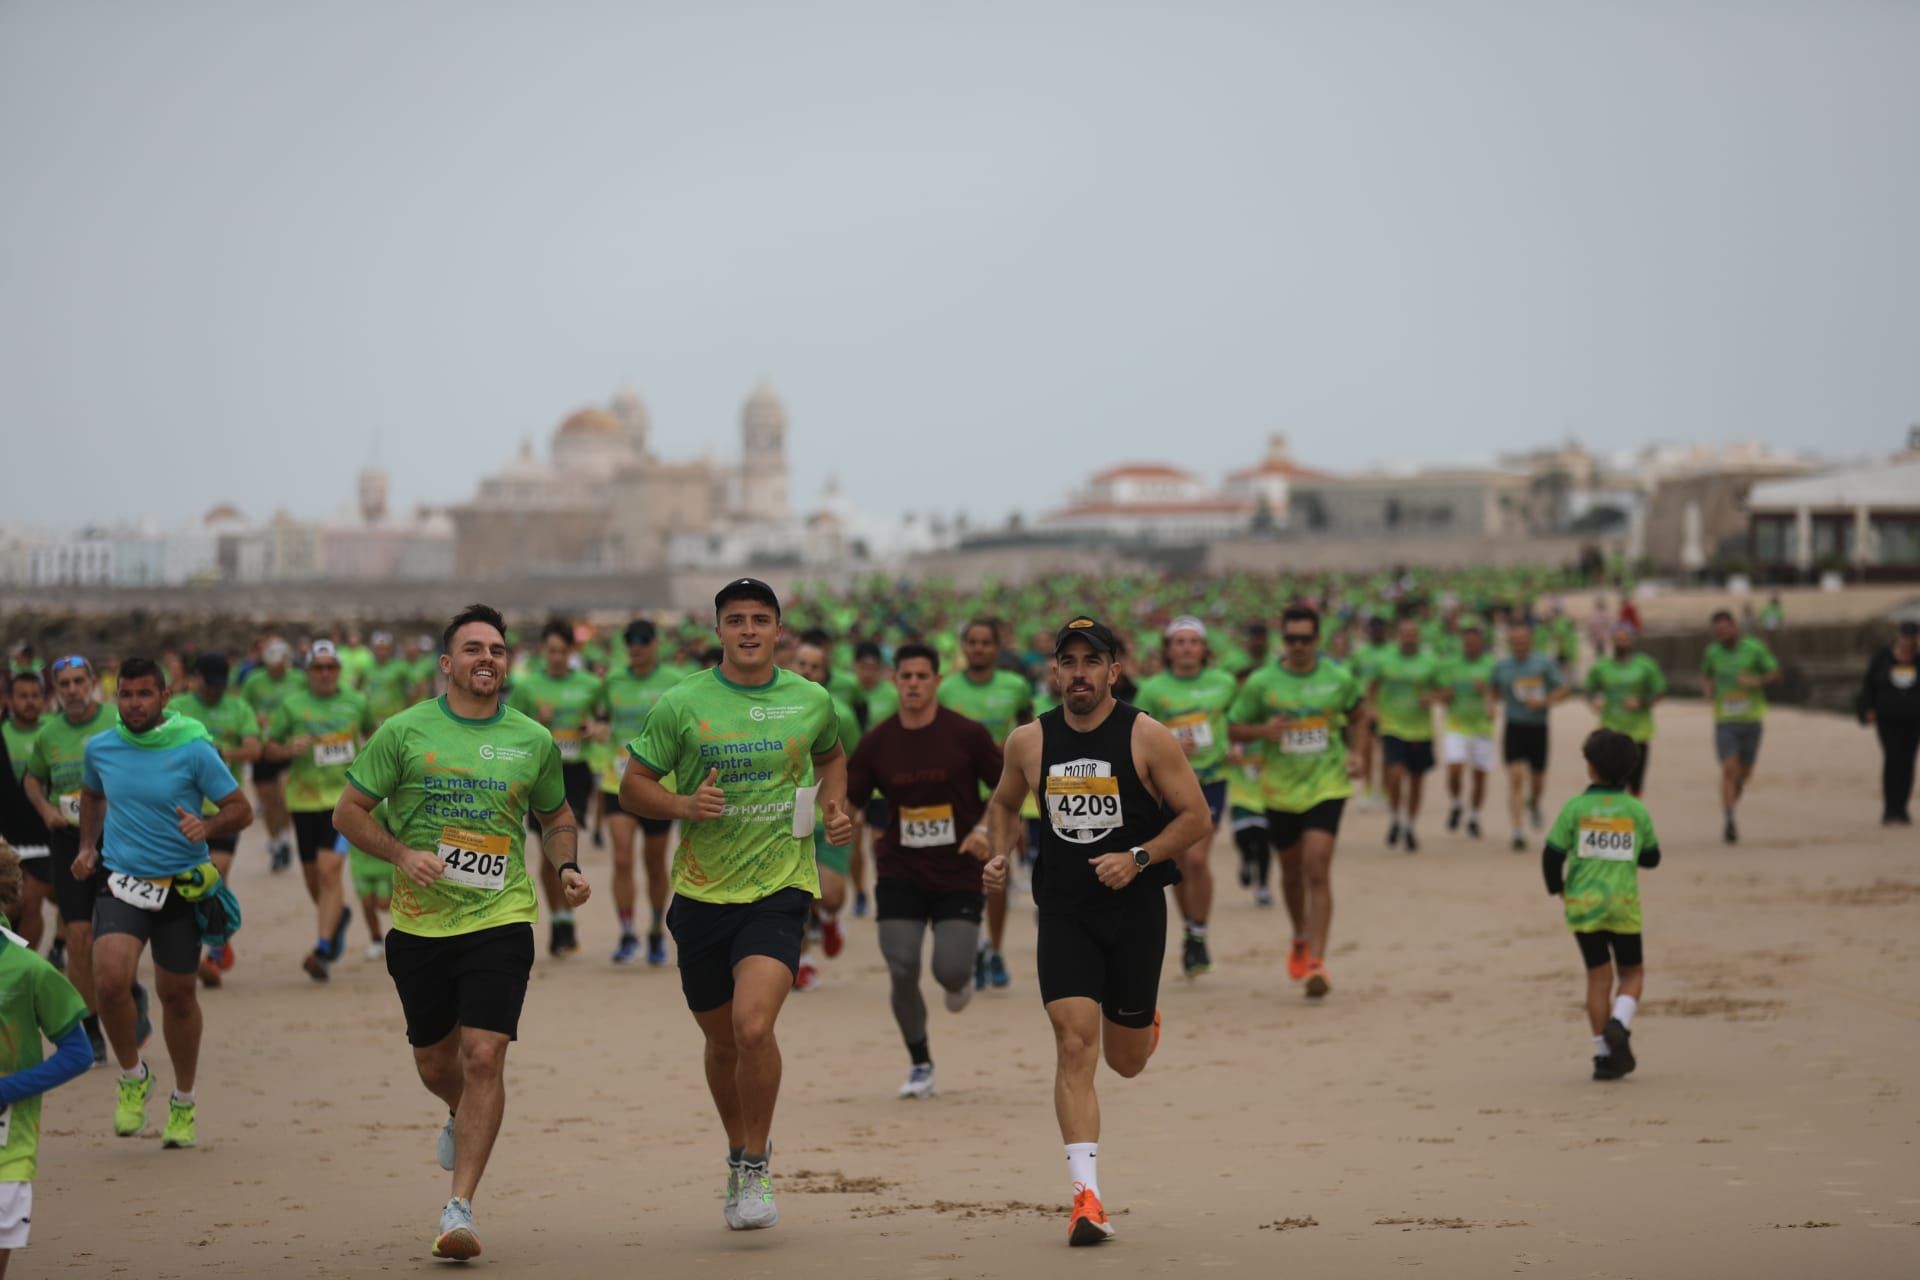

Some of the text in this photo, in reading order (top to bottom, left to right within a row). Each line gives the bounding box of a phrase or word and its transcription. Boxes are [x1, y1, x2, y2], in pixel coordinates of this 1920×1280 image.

[700, 739, 783, 757] En marcha
[721, 769, 773, 784] cáncer
[1064, 763, 1097, 778] MOTOR
[424, 776, 507, 792] En marcha
[441, 805, 495, 820] cáncer
[1058, 795, 1118, 817] 4209
[906, 819, 950, 838] 4357
[1586, 831, 1632, 850] 4608
[445, 848, 505, 877] 4205
[117, 874, 165, 903] 4721
